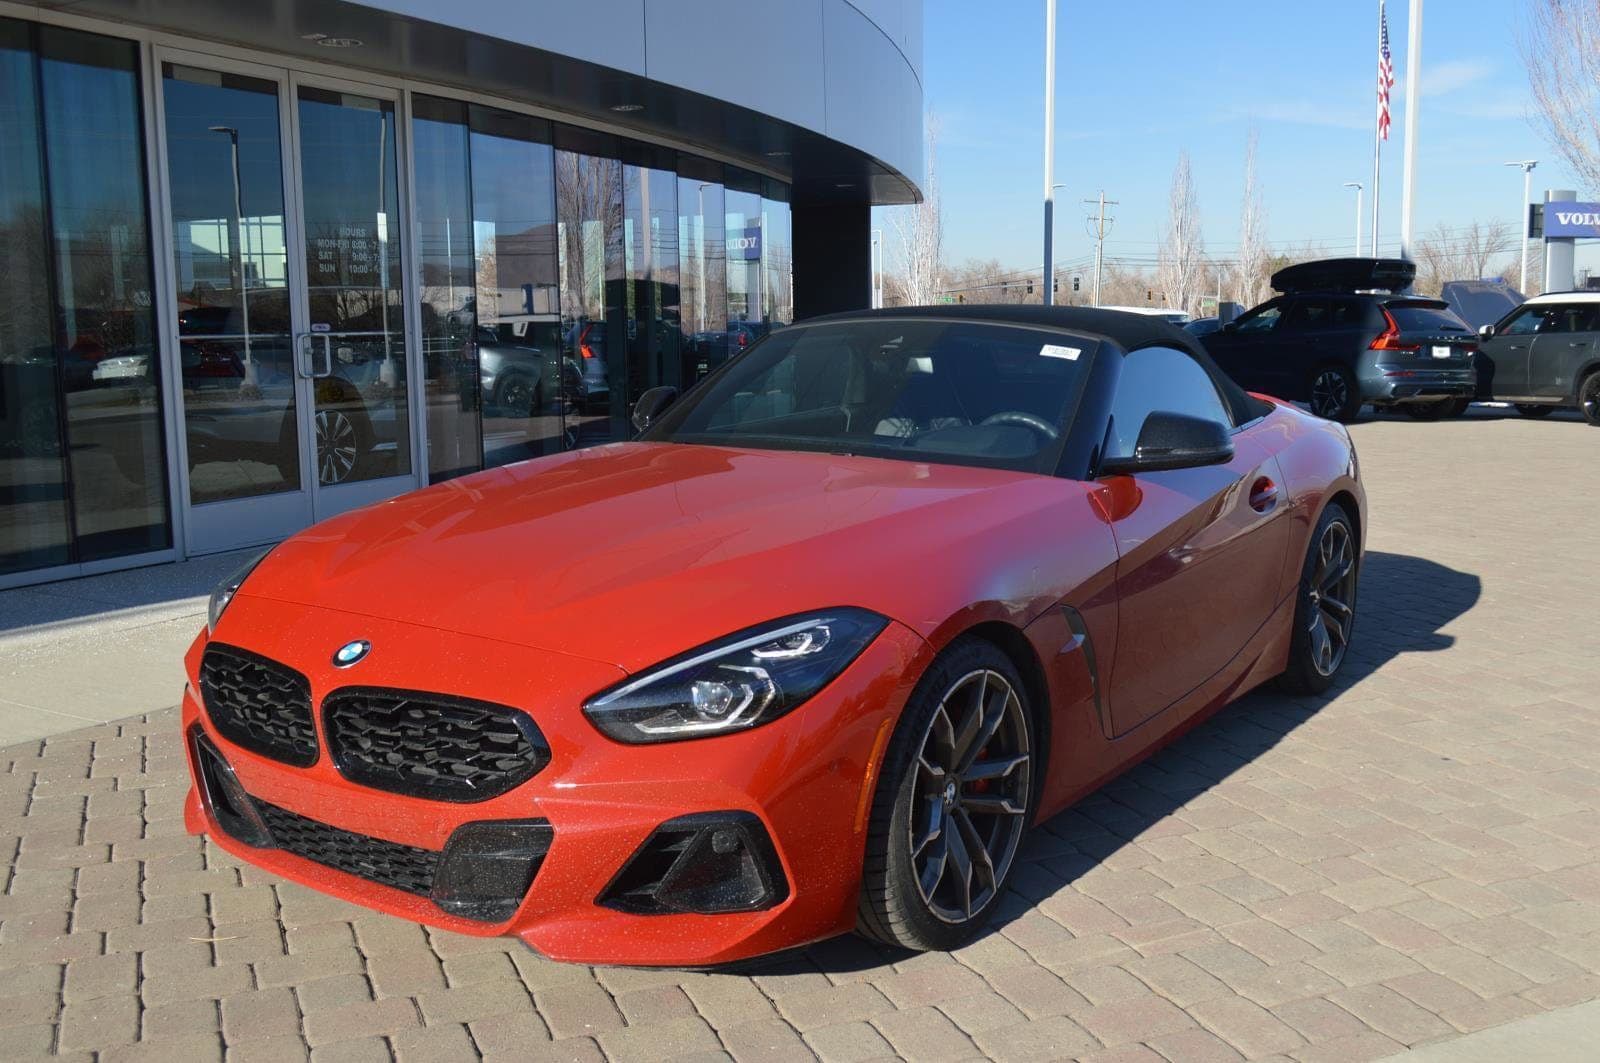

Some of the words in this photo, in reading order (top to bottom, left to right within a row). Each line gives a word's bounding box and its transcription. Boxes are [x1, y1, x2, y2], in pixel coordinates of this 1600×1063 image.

[339, 225, 366, 237] HOURS
[351, 240, 367, 249] 8:00
[318, 251, 333, 260] SAT
[319, 263, 336, 273] SUN
